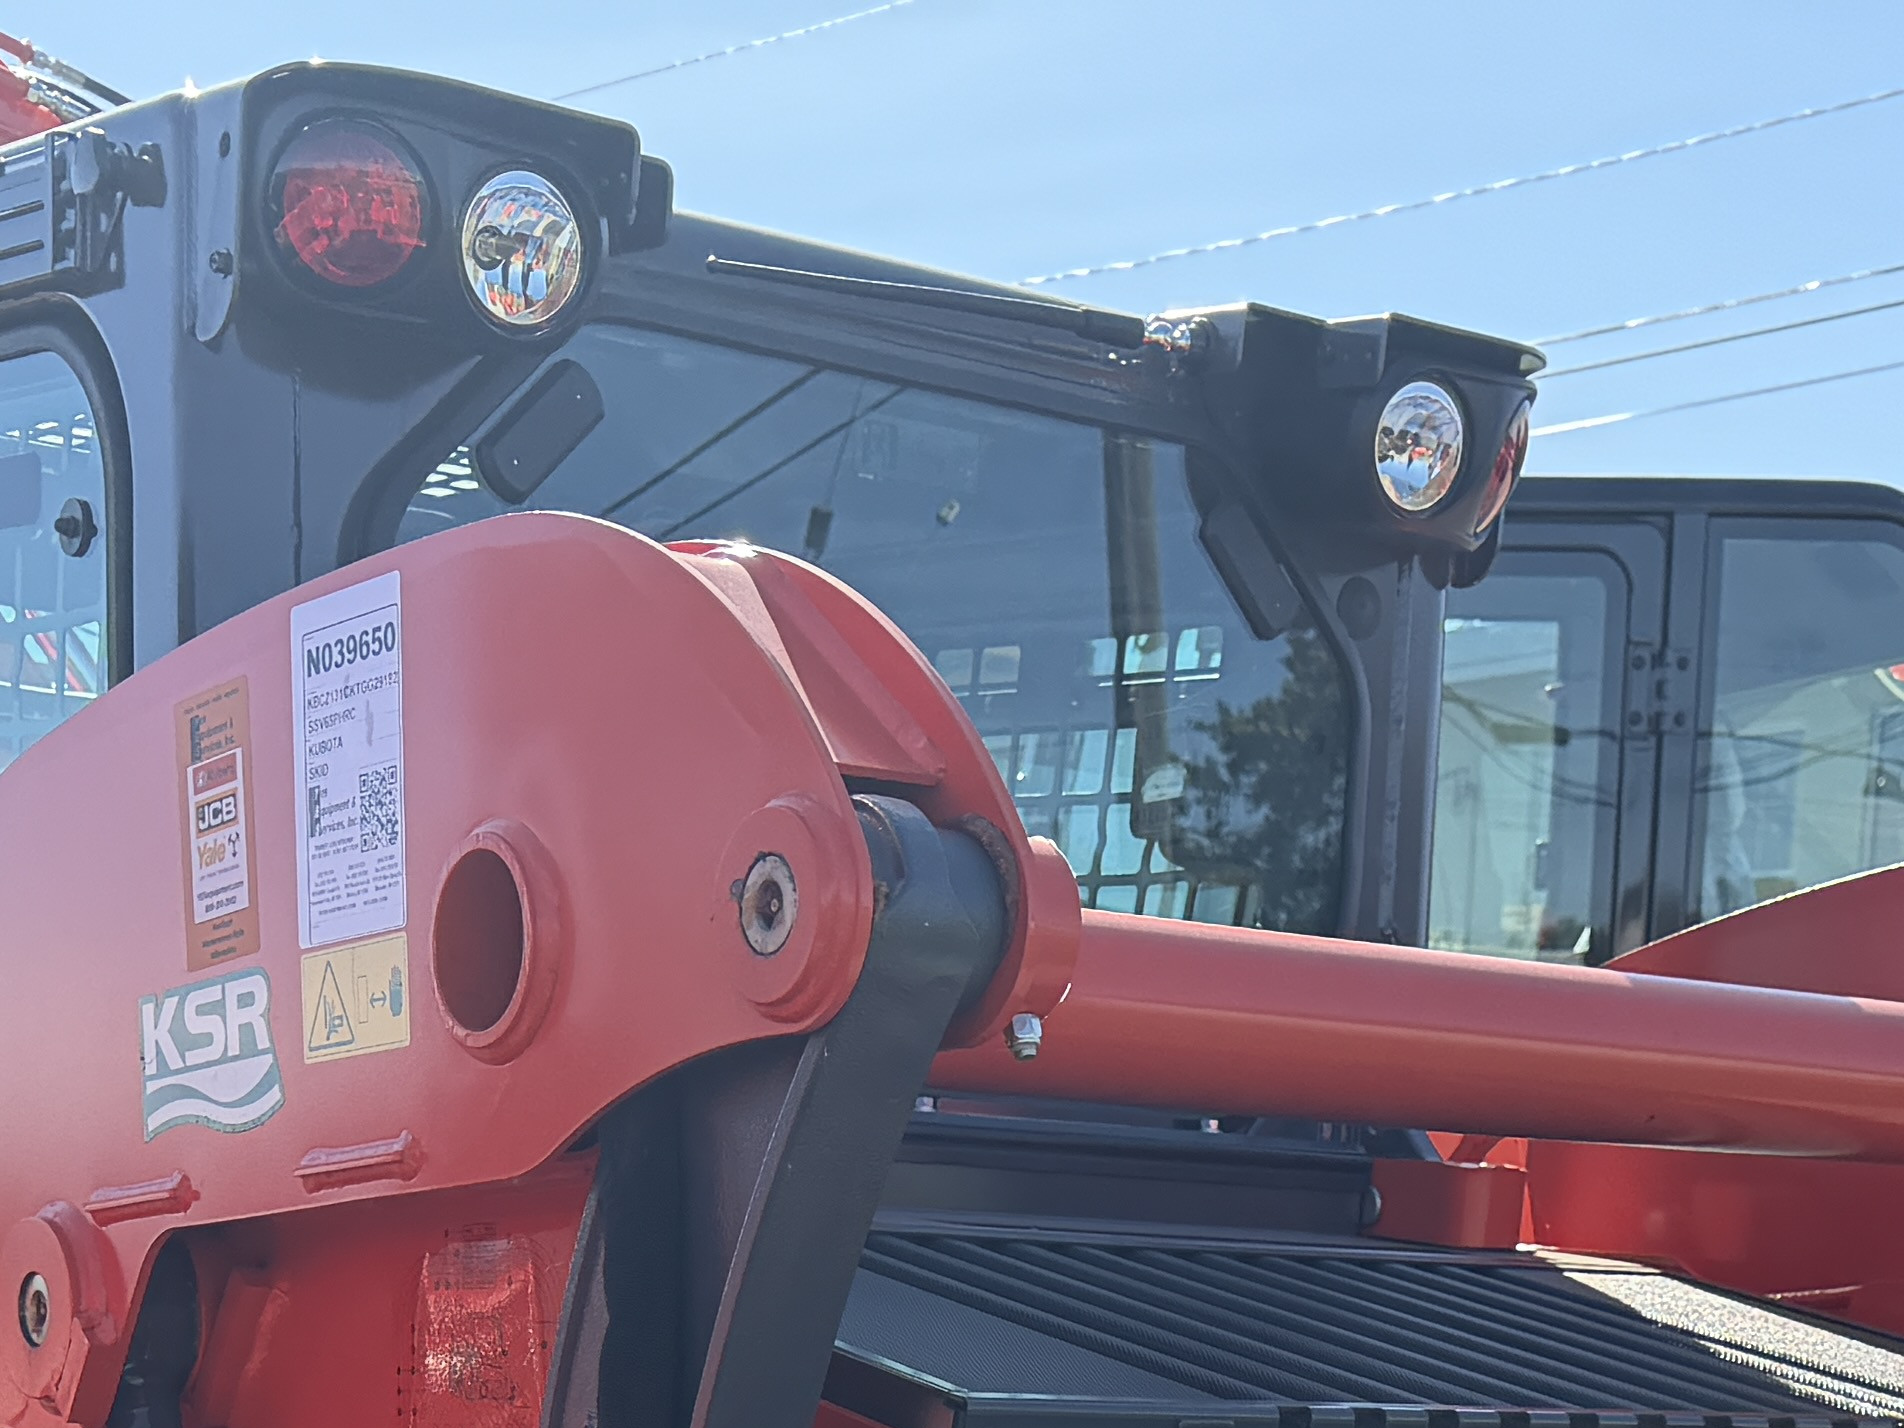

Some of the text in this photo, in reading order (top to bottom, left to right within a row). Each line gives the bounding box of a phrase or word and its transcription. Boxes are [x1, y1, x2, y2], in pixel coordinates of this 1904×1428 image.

[306, 621, 396, 678] N039650
[308, 736, 343, 758] KUBOTA
[309, 763, 329, 780] SKID
[198, 796, 236, 831] JCB
[197, 838, 226, 870] Yale
[142, 974, 271, 1076] KSR
